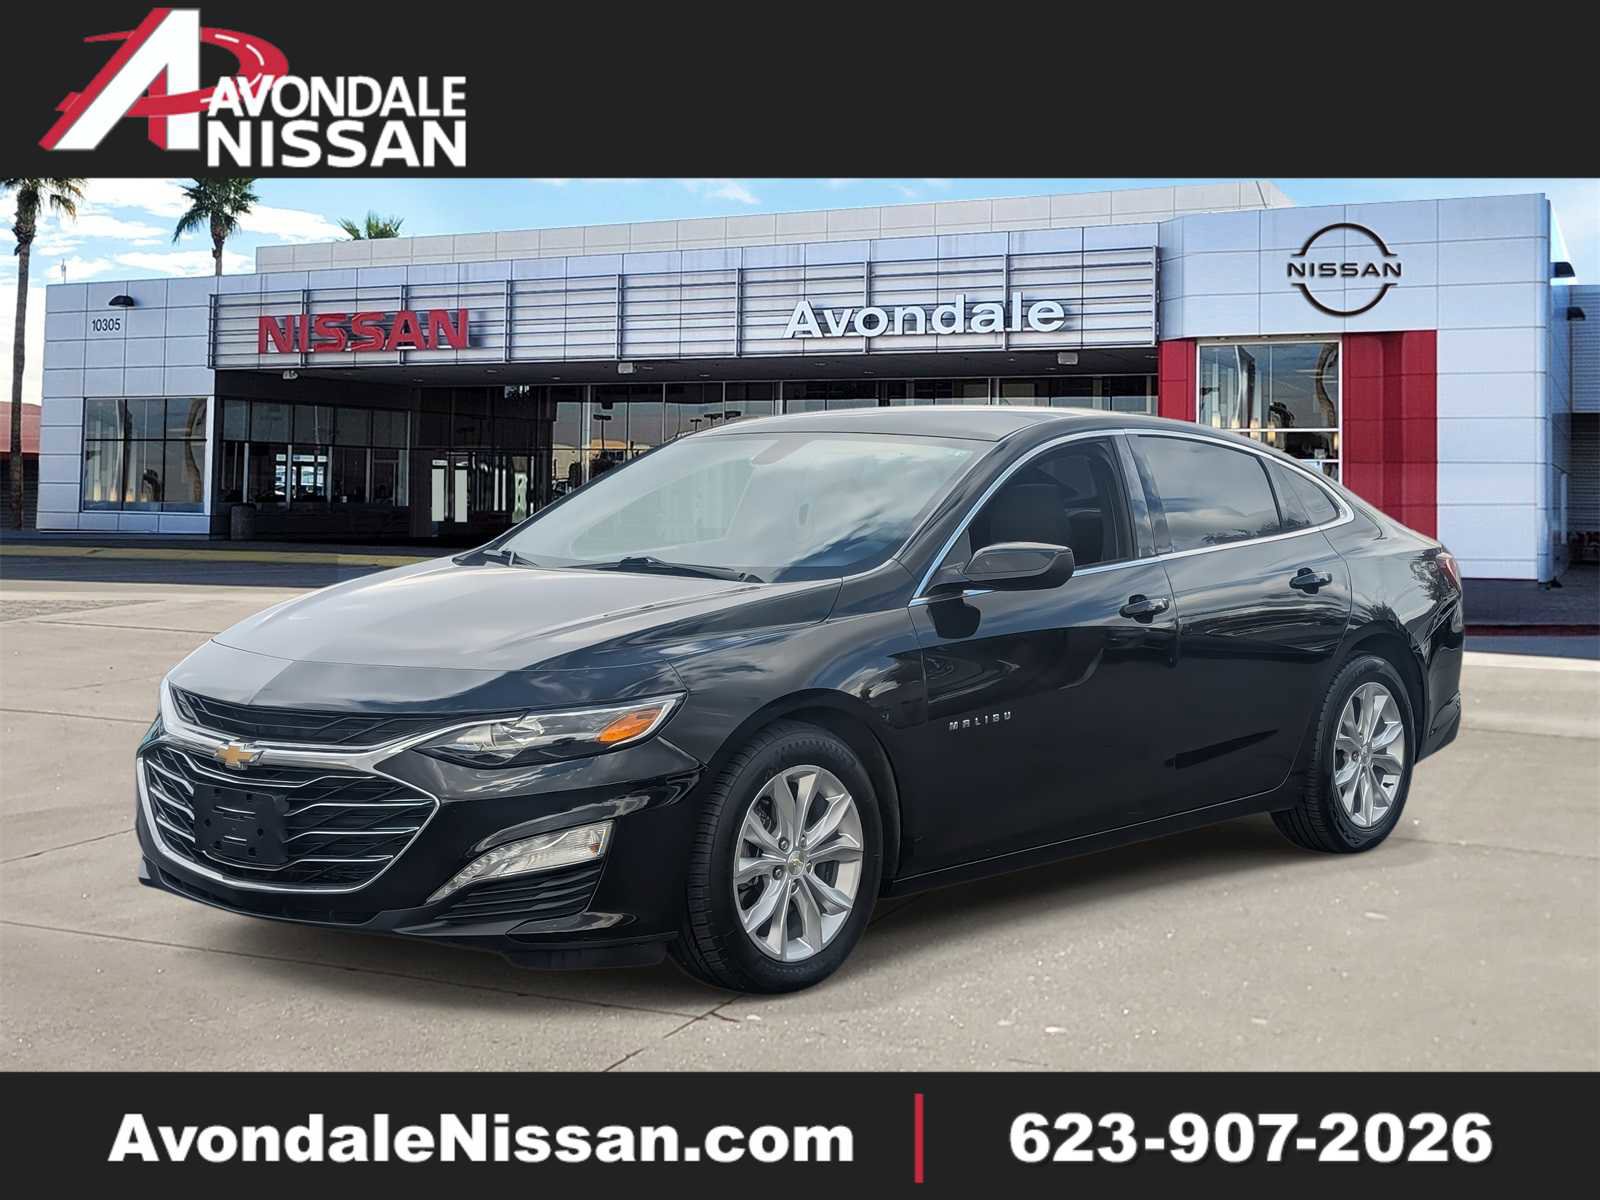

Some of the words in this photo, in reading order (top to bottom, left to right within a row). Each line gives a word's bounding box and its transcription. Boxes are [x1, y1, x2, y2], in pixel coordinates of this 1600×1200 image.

[1287, 262, 1402, 278] NISSAN
[783, 291, 1066, 338] Avondale
[92, 318, 121, 332] 10305
[258, 308, 470, 354] NISSAN
[948, 711, 1012, 731] MALIBU
